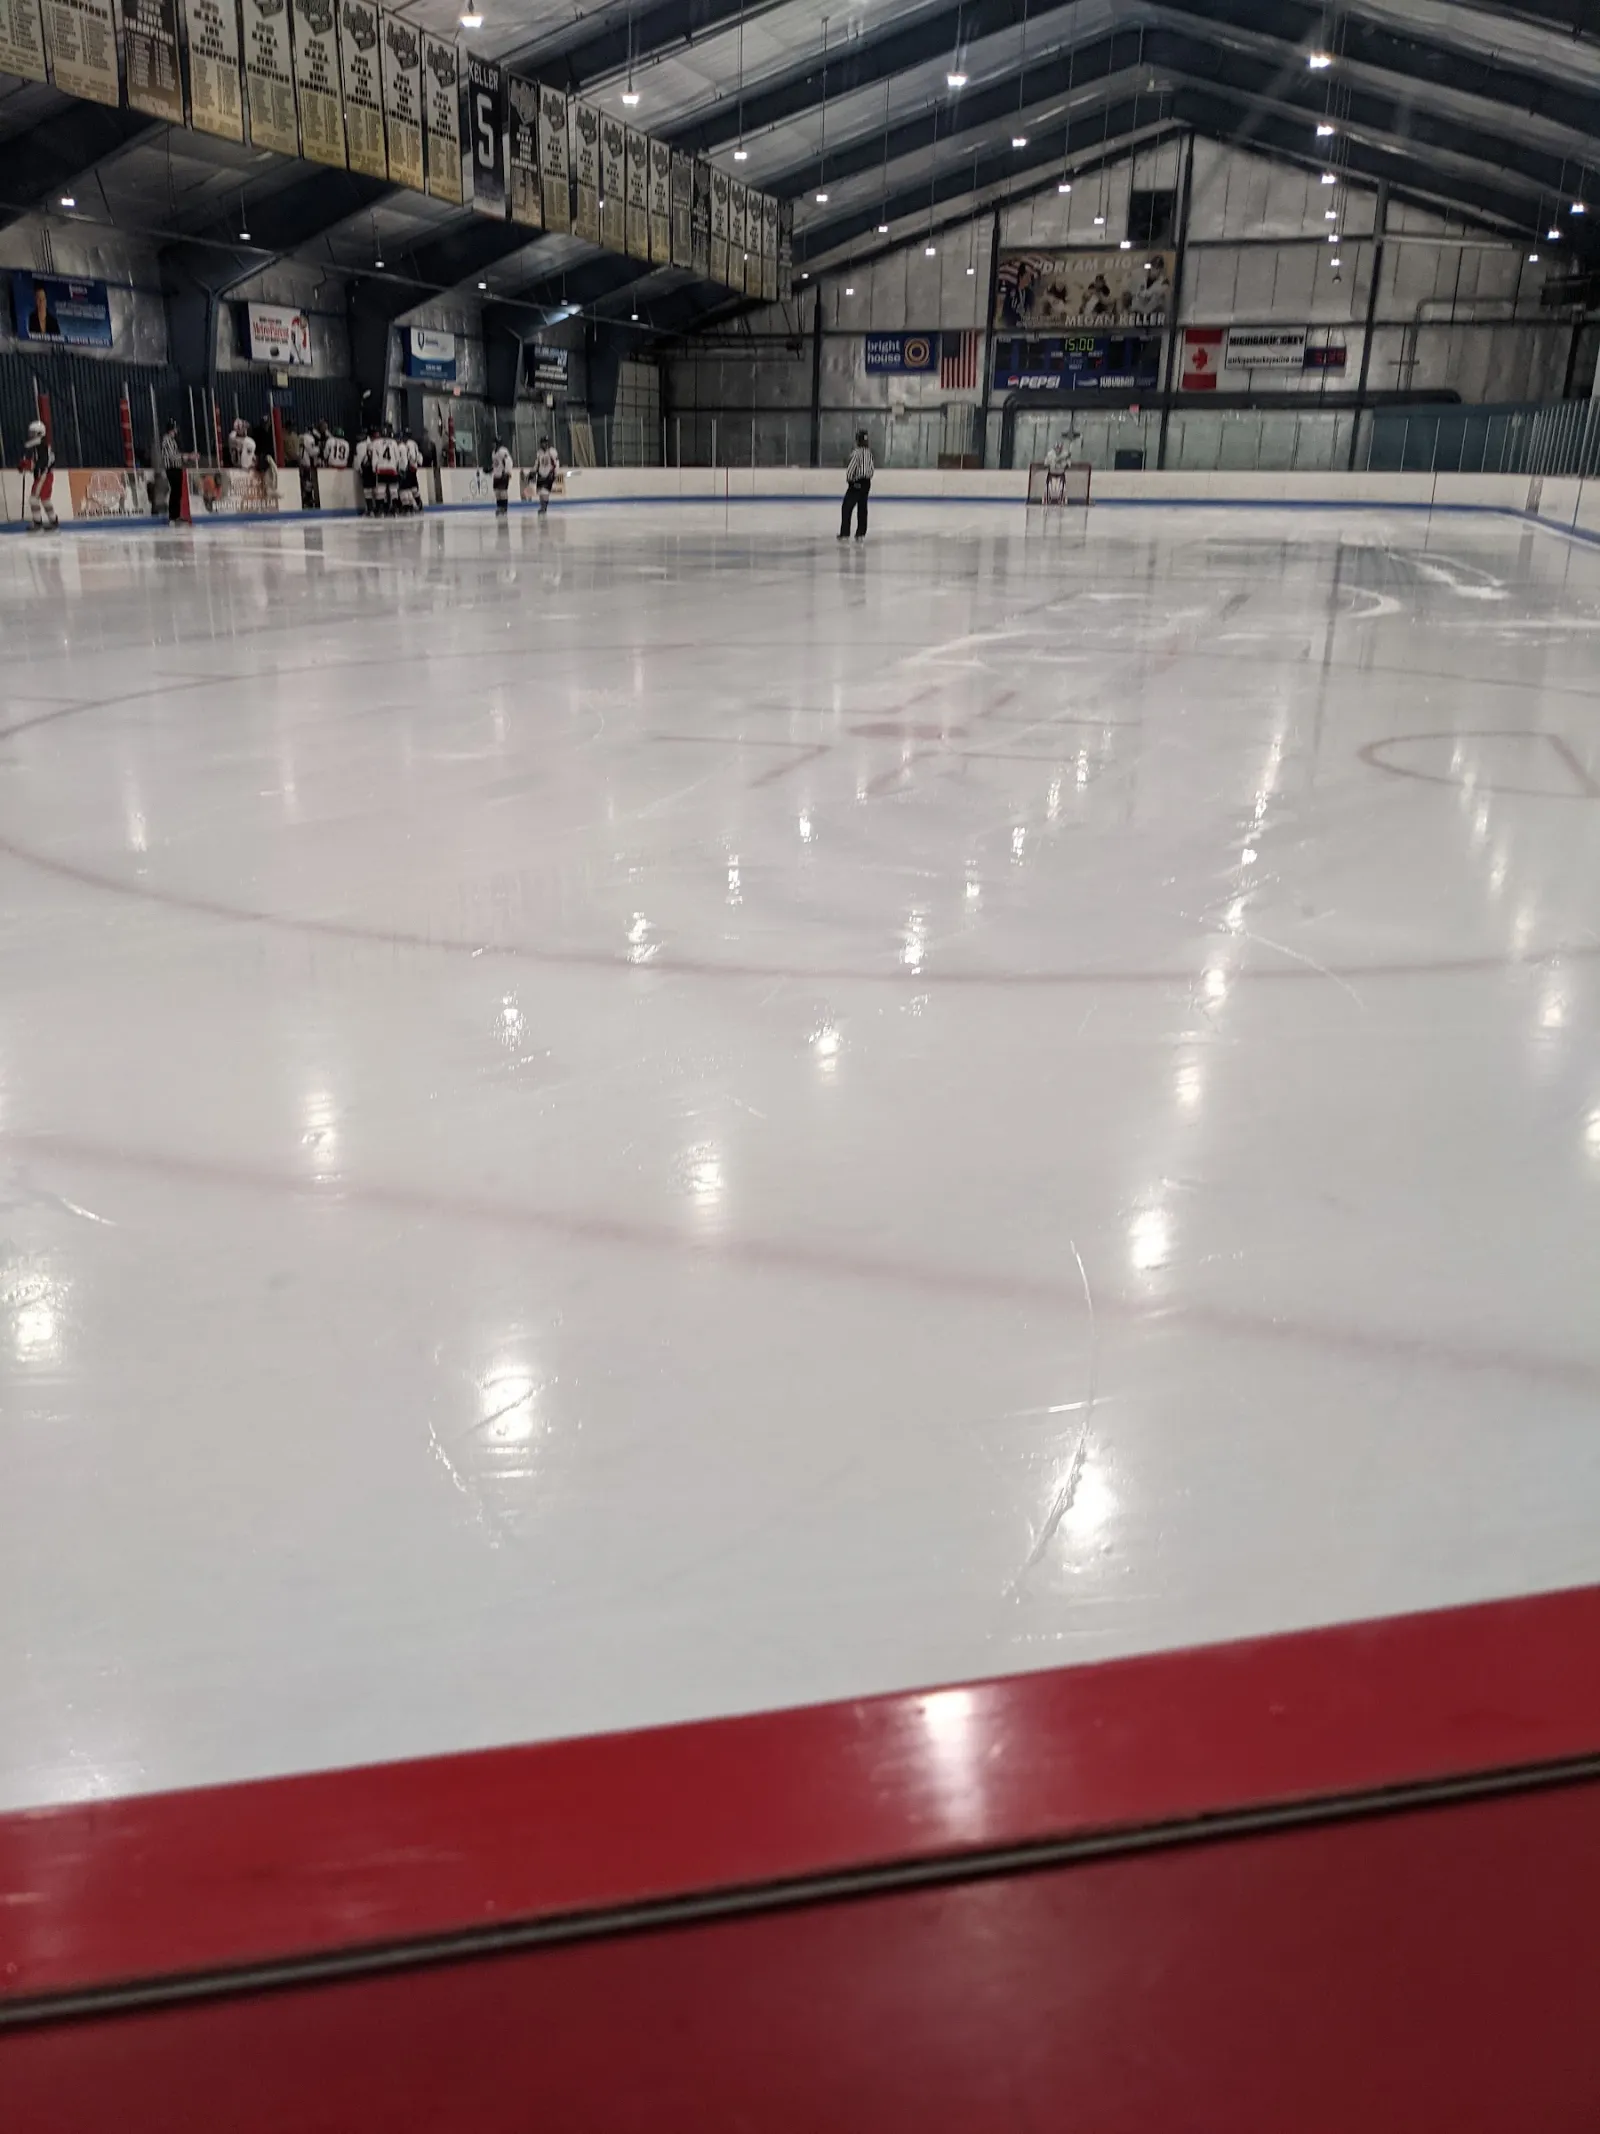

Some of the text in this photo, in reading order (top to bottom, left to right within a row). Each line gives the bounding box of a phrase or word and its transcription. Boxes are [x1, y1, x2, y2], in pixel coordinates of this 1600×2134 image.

[468, 60, 499, 92] KELLER
[476, 92, 494, 169] 5
[1064, 315, 1115, 327] MEGAN
[1118, 313, 1166, 327] KELLER
[867, 339, 900, 353] bright
[867, 352, 900, 365] house
[1019, 375, 1061, 389] PEPSI
[333, 443, 346, 460] 19
[382, 445, 391, 461] 4
